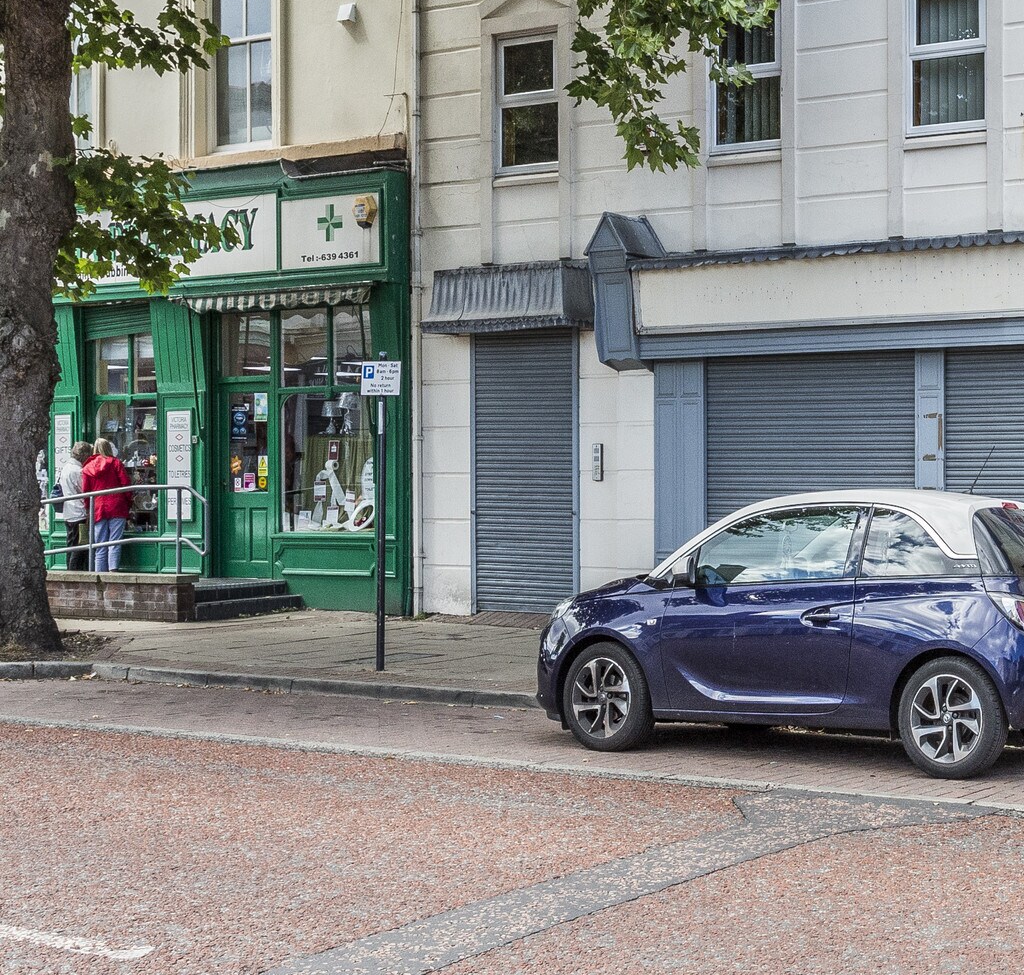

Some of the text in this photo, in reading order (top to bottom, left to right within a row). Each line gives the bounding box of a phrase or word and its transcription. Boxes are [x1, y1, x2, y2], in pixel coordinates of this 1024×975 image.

[338, 250, 359, 260] 4361
[366, 367, 373, 378] P
[55, 446, 72, 454] GIFTS
[168, 444, 192, 452] COSMETICS
